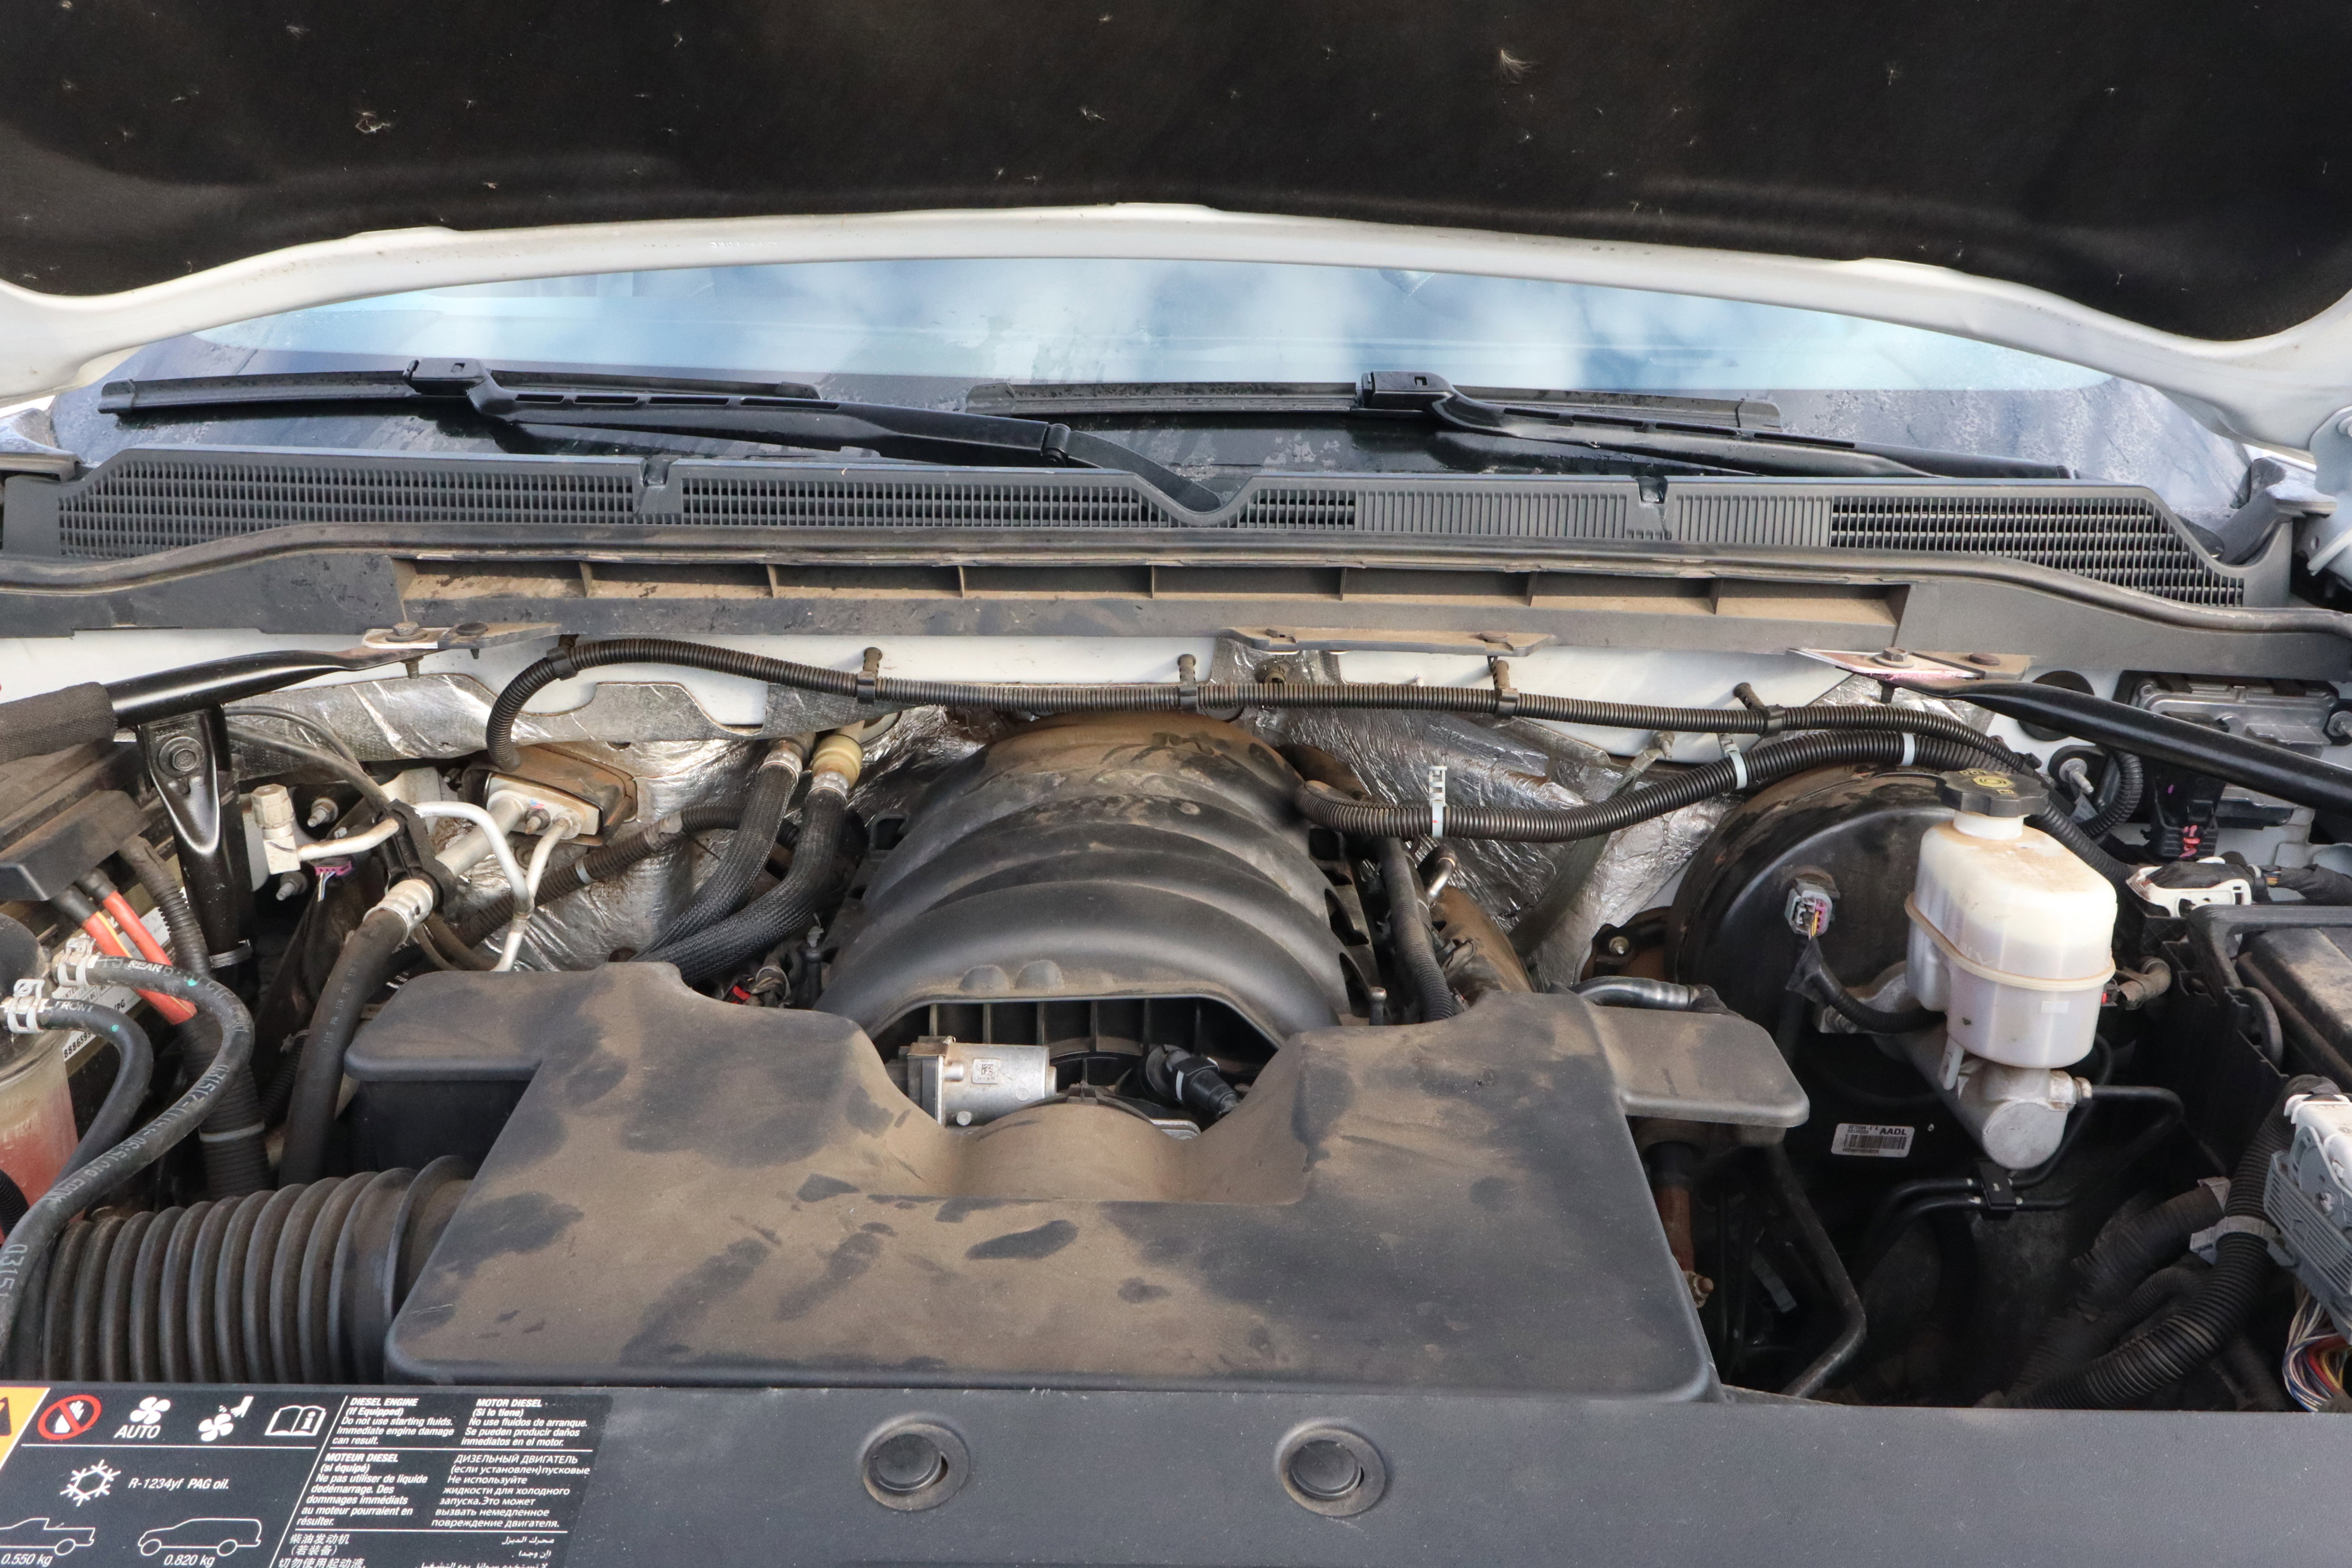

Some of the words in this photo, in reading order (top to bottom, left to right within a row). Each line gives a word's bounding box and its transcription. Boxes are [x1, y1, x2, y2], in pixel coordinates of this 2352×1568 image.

[127, 960, 164, 973] REAR
[350, 1397, 382, 1406] DIESEL
[383, 1398, 419, 1407] ENGINE
[476, 1399, 510, 1407] MOTOR
[511, 1399, 542, 1408] DIESEL
[345, 1407, 358, 1417] (If
[358, 1407, 404, 1417] Equipped)
[472, 1408, 484, 1417] (Si
[487, 1408, 497, 1417] lo
[498, 1409, 524, 1418] tiene)
[341, 1417, 353, 1425] Do
[355, 1417, 370, 1425] not
[390, 1417, 425, 1427] starting
[426, 1417, 453, 1426] fluids.
[468, 1418, 481, 1426] No
[501, 1418, 532, 1427] fluidos
[533, 1419, 545, 1427] de
[546, 1420, 588, 1428] arranque.
[114, 1424, 161, 1439] AUTO
[336, 1426, 385, 1435] Immediate
[386, 1427, 416, 1437] engine
[418, 1427, 454, 1438] damage
[465, 1427, 477, 1436] Se
[478, 1428, 512, 1437] pueden
[513, 1428, 552, 1437] producir
[552, 1428, 580, 1437] daños
[351, 1436, 379, 1445] result.
[461, 1437, 510, 1446] inmediatos
[526, 1438, 535, 1446] el
[536, 1438, 564, 1446] motor.
[324, 1453, 365, 1462] MOTEUR
[366, 1453, 399, 1463] DIESEL
[454, 1453, 519, 1465] ДИЗЕЛЬНЫЙ
[520, 1455, 578, 1465] ДВИГАТЕЛЬ
[320, 1463, 332, 1474] (si
[334, 1463, 370, 1474] équipé)
[450, 1464, 478, 1475] (если
[128, 1478, 184, 1491] R-1234yf
[187, 1479, 212, 1489] PAG
[213, 1479, 229, 1489] oil.
[315, 1474, 328, 1482] Ne
[330, 1476, 347, 1485] pas
[349, 1474, 383, 1483] utiliser
[383, 1475, 396, 1483] de
[396, 1474, 428, 1485] liquide
[447, 1475, 461, 1483] Не
[463, 1476, 528, 1486] используйте
[310, 1484, 374, 1495] dedémarrage.
[376, 1485, 395, 1494] Des
[442, 1487, 493, 1495] жидкости
[494, 1487, 514, 1496] для
[515, 1488, 570, 1497] холодного
[306, 1494, 358, 1506] dommages
[359, 1495, 408, 1505] immédiats
[301, 1507, 314, 1515] au
[315, 1507, 350, 1515] moteur
[350, 1507, 400, 1517] pourraient
[479, 1509, 550, 1517] немедленное
[296, 1516, 335, 1526] résulter.
[431, 1519, 503, 1528] повреждение
[504, 1520, 560, 1529] двигателя.
[289, 1533, 350, 1545] 柴油发动机
[501, 1536, 528, 1545] الديزل
[528, 1536, 555, 1545] محرك
[0, 1552, 36, 1566] 0.550
[37, 1554, 53, 1567] kg
[164, 1555, 199, 1566] 0.820
[200, 1555, 216, 1568] kg
